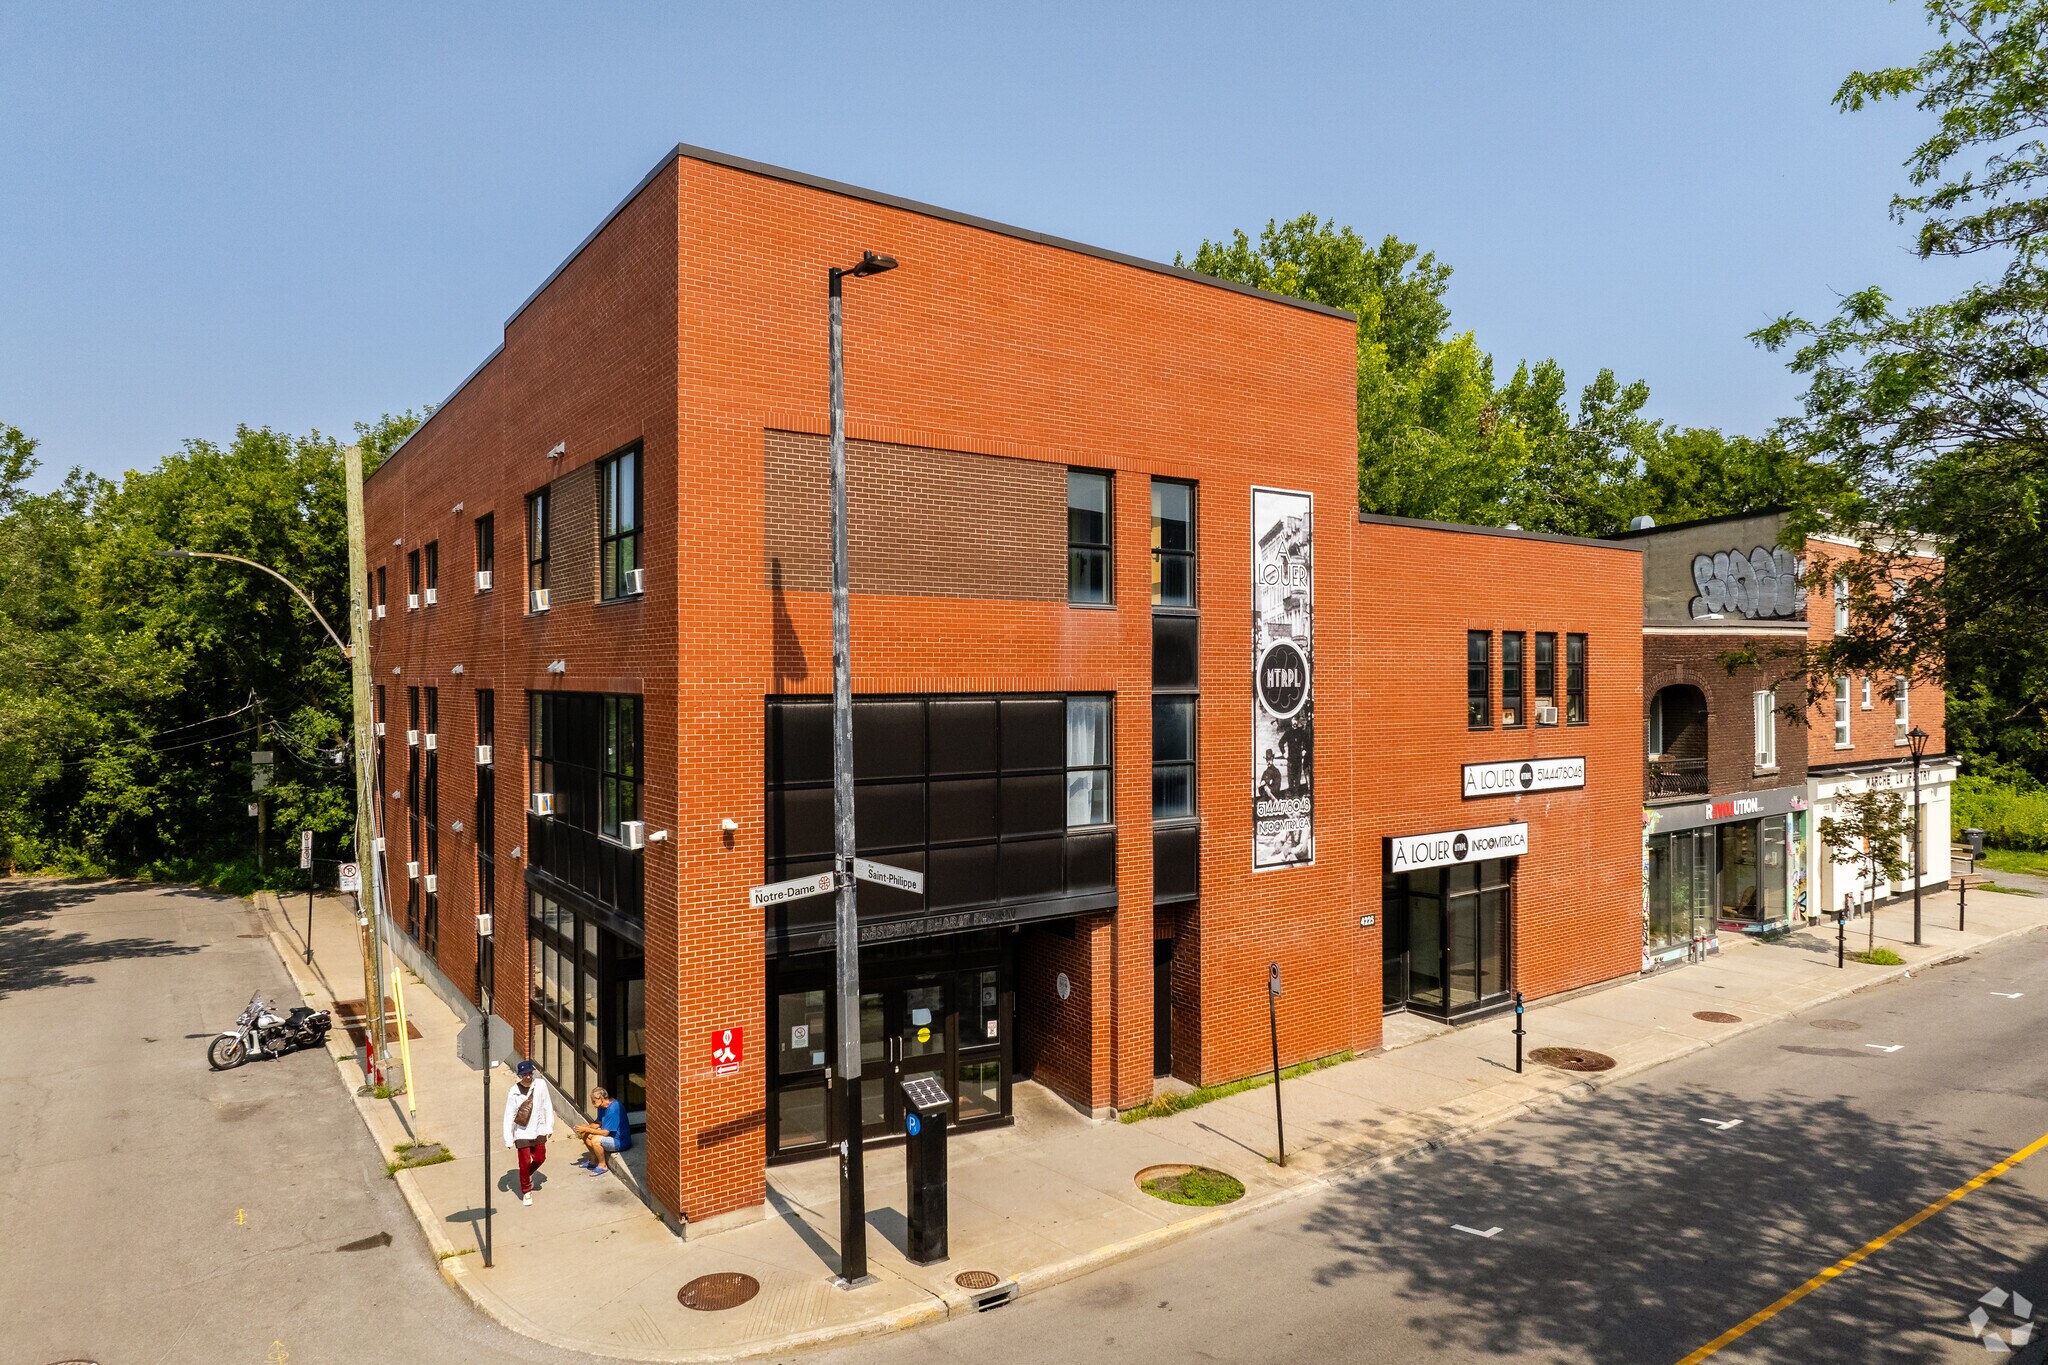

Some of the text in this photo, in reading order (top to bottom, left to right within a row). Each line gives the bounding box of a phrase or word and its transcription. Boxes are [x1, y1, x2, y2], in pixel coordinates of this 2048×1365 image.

[1275, 534, 1291, 562] À
[1258, 563, 1307, 587] LOUER
[1267, 668, 1301, 687] MTRPL
[1465, 767, 1477, 791] À
[1480, 769, 1515, 790] LOUER
[1908, 769, 1931, 783] PTRY
[1394, 840, 1408, 866] À
[1411, 840, 1450, 864] LOUER
[868, 868, 917, 889] Saint-Philippe
[755, 885, 815, 904] Notre-Dame
